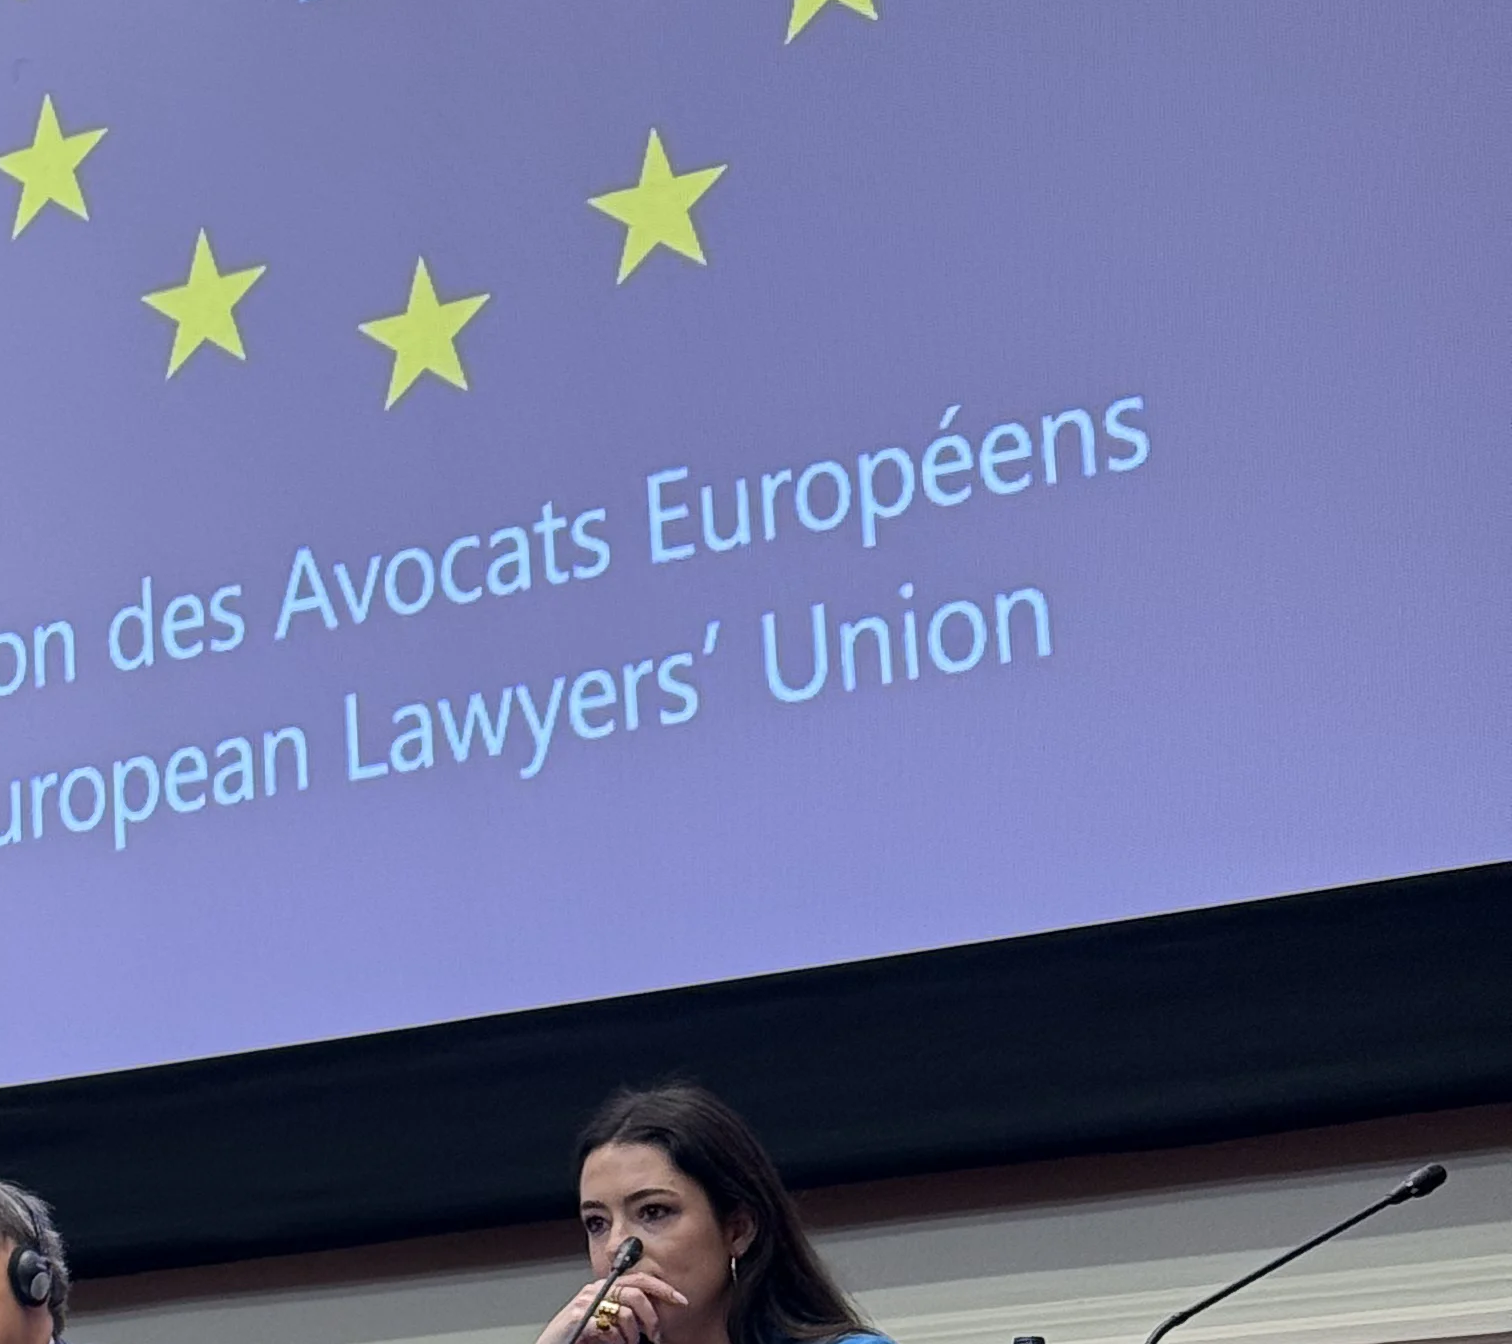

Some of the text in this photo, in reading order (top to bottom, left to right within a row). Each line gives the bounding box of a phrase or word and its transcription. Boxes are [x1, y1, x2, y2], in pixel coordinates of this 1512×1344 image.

[107, 576, 246, 673] des
[274, 501, 612, 641] Avocats
[646, 395, 1152, 565] Européens
[761, 581, 1052, 704] Union
